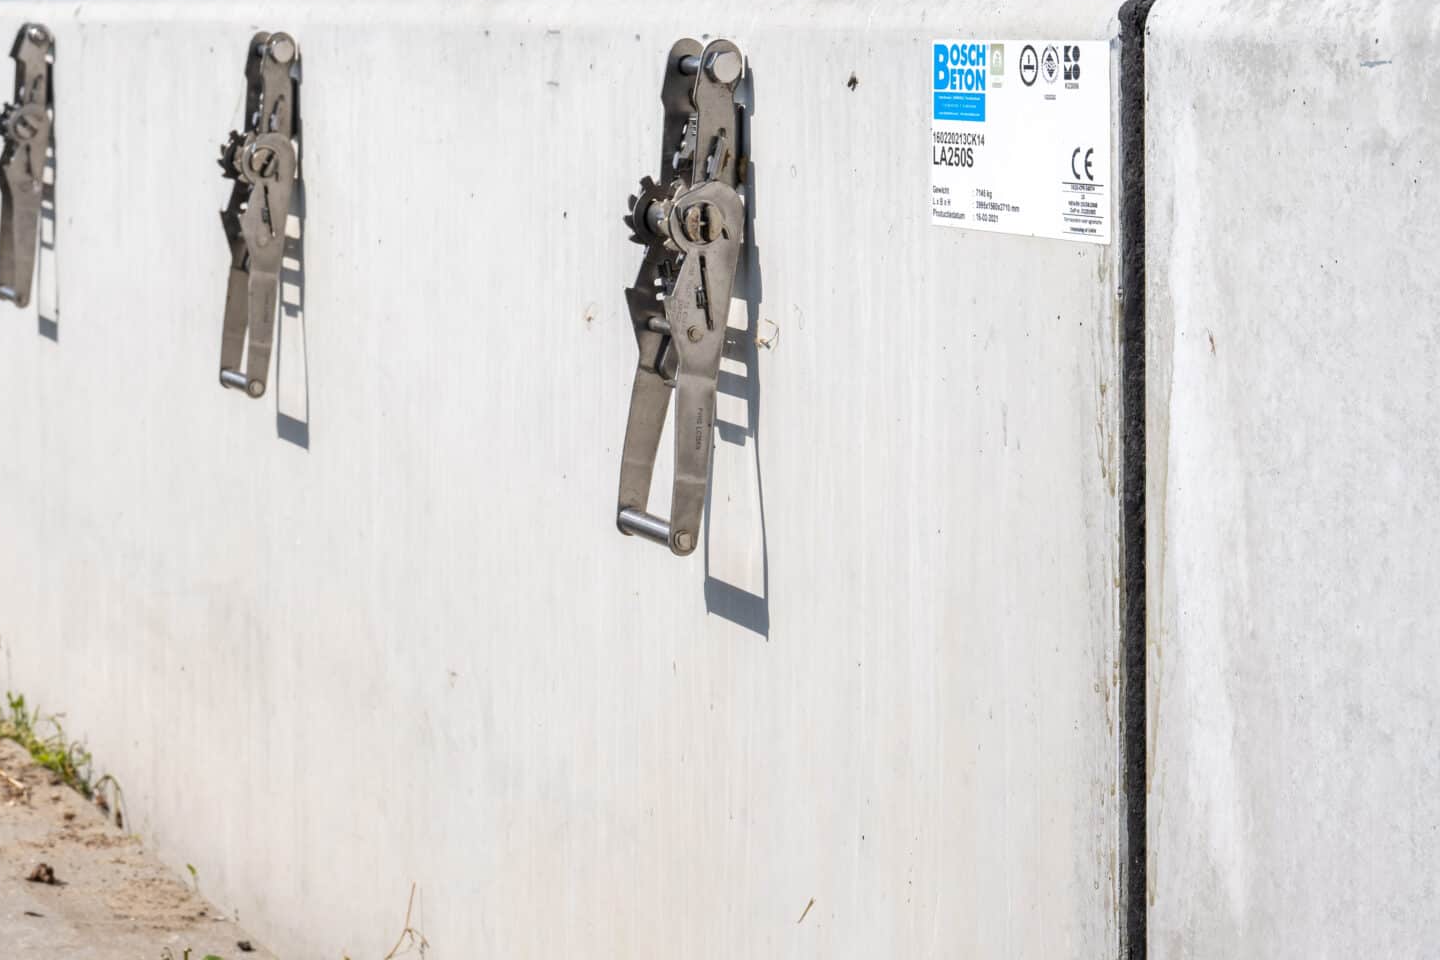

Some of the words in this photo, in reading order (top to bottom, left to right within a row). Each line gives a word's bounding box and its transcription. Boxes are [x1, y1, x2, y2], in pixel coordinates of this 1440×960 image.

[934, 44, 986, 66] BOSCH
[934, 67, 986, 91] BETON
[933, 145, 974, 168] LA250S
